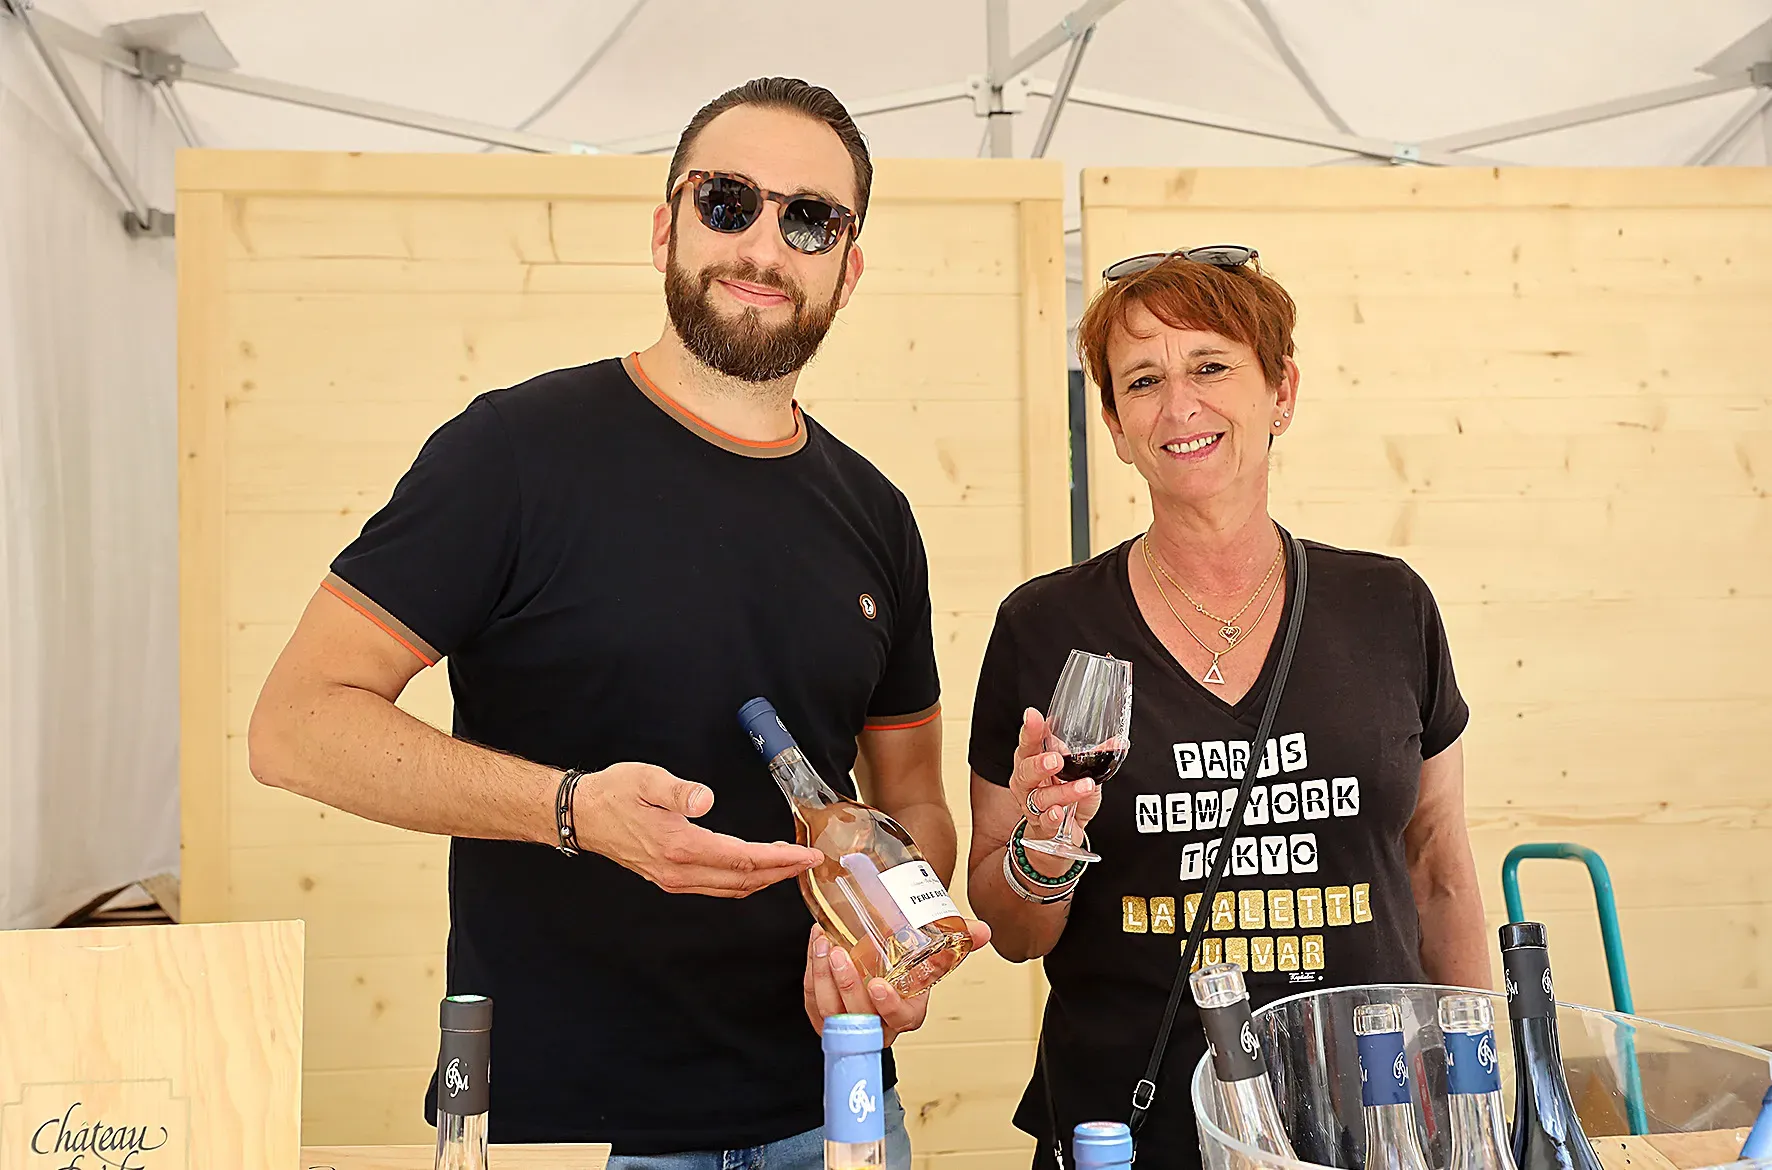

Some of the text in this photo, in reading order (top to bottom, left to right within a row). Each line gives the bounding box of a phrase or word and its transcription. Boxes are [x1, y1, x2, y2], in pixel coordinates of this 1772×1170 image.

[1179, 740, 1302, 772] PARIS
[1139, 784, 1357, 826] NEW-YORK
[1127, 901, 1174, 927] LA
[30, 1101, 169, 1164] Château
